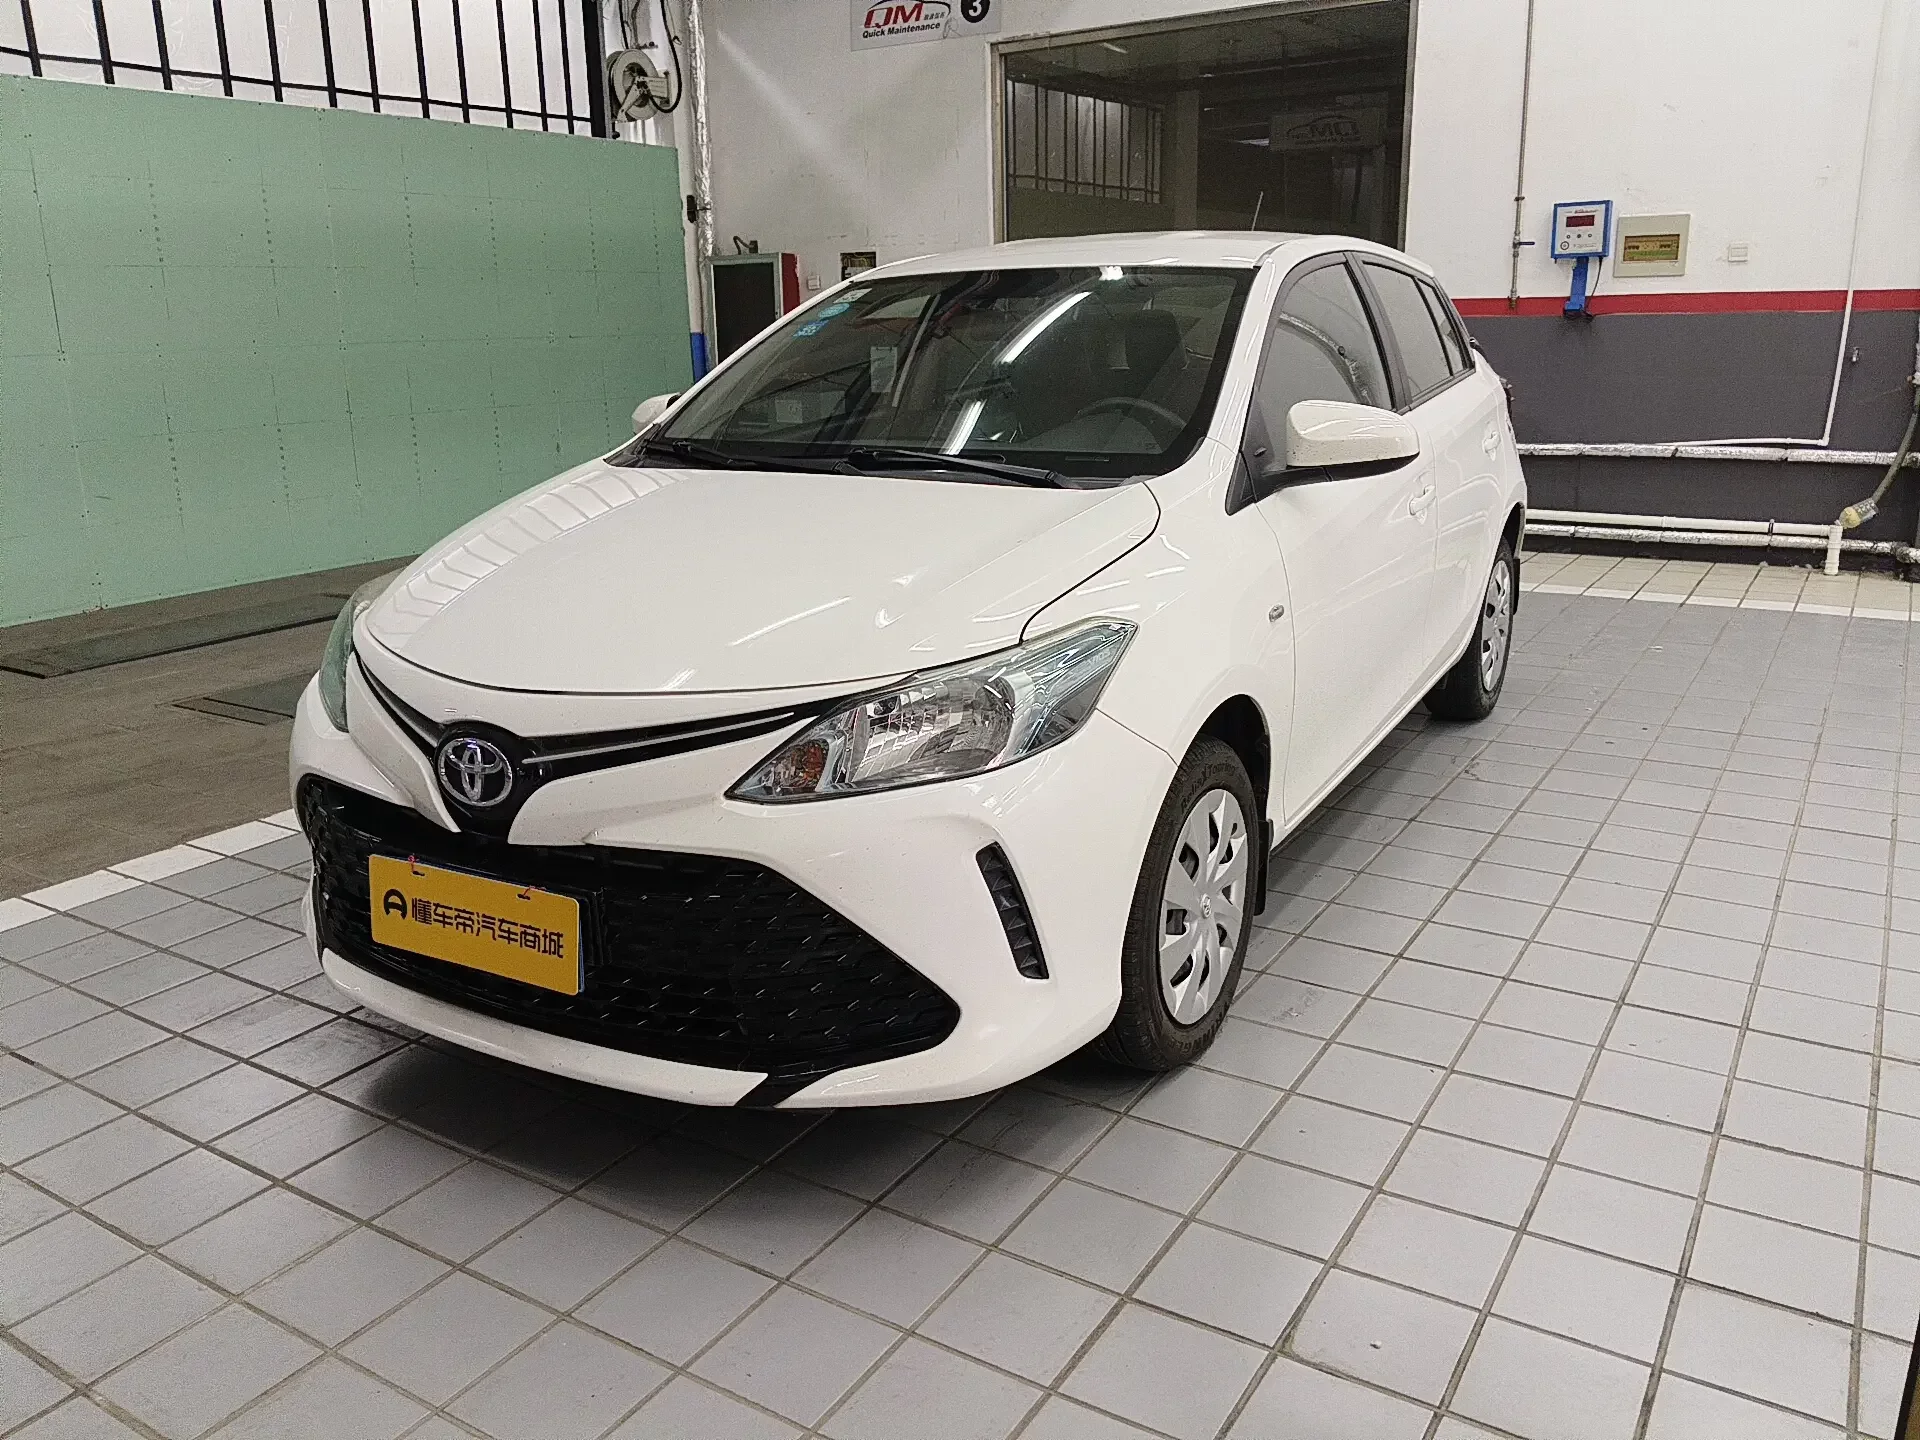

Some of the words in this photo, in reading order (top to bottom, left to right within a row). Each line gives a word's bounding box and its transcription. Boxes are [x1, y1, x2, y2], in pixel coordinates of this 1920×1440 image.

[969, 0, 983, 17] 3
[862, 27, 886, 38] Quick
[886, 22, 941, 36] Maintenance
[411, 896, 564, 959] 懂车帝汽车商城
